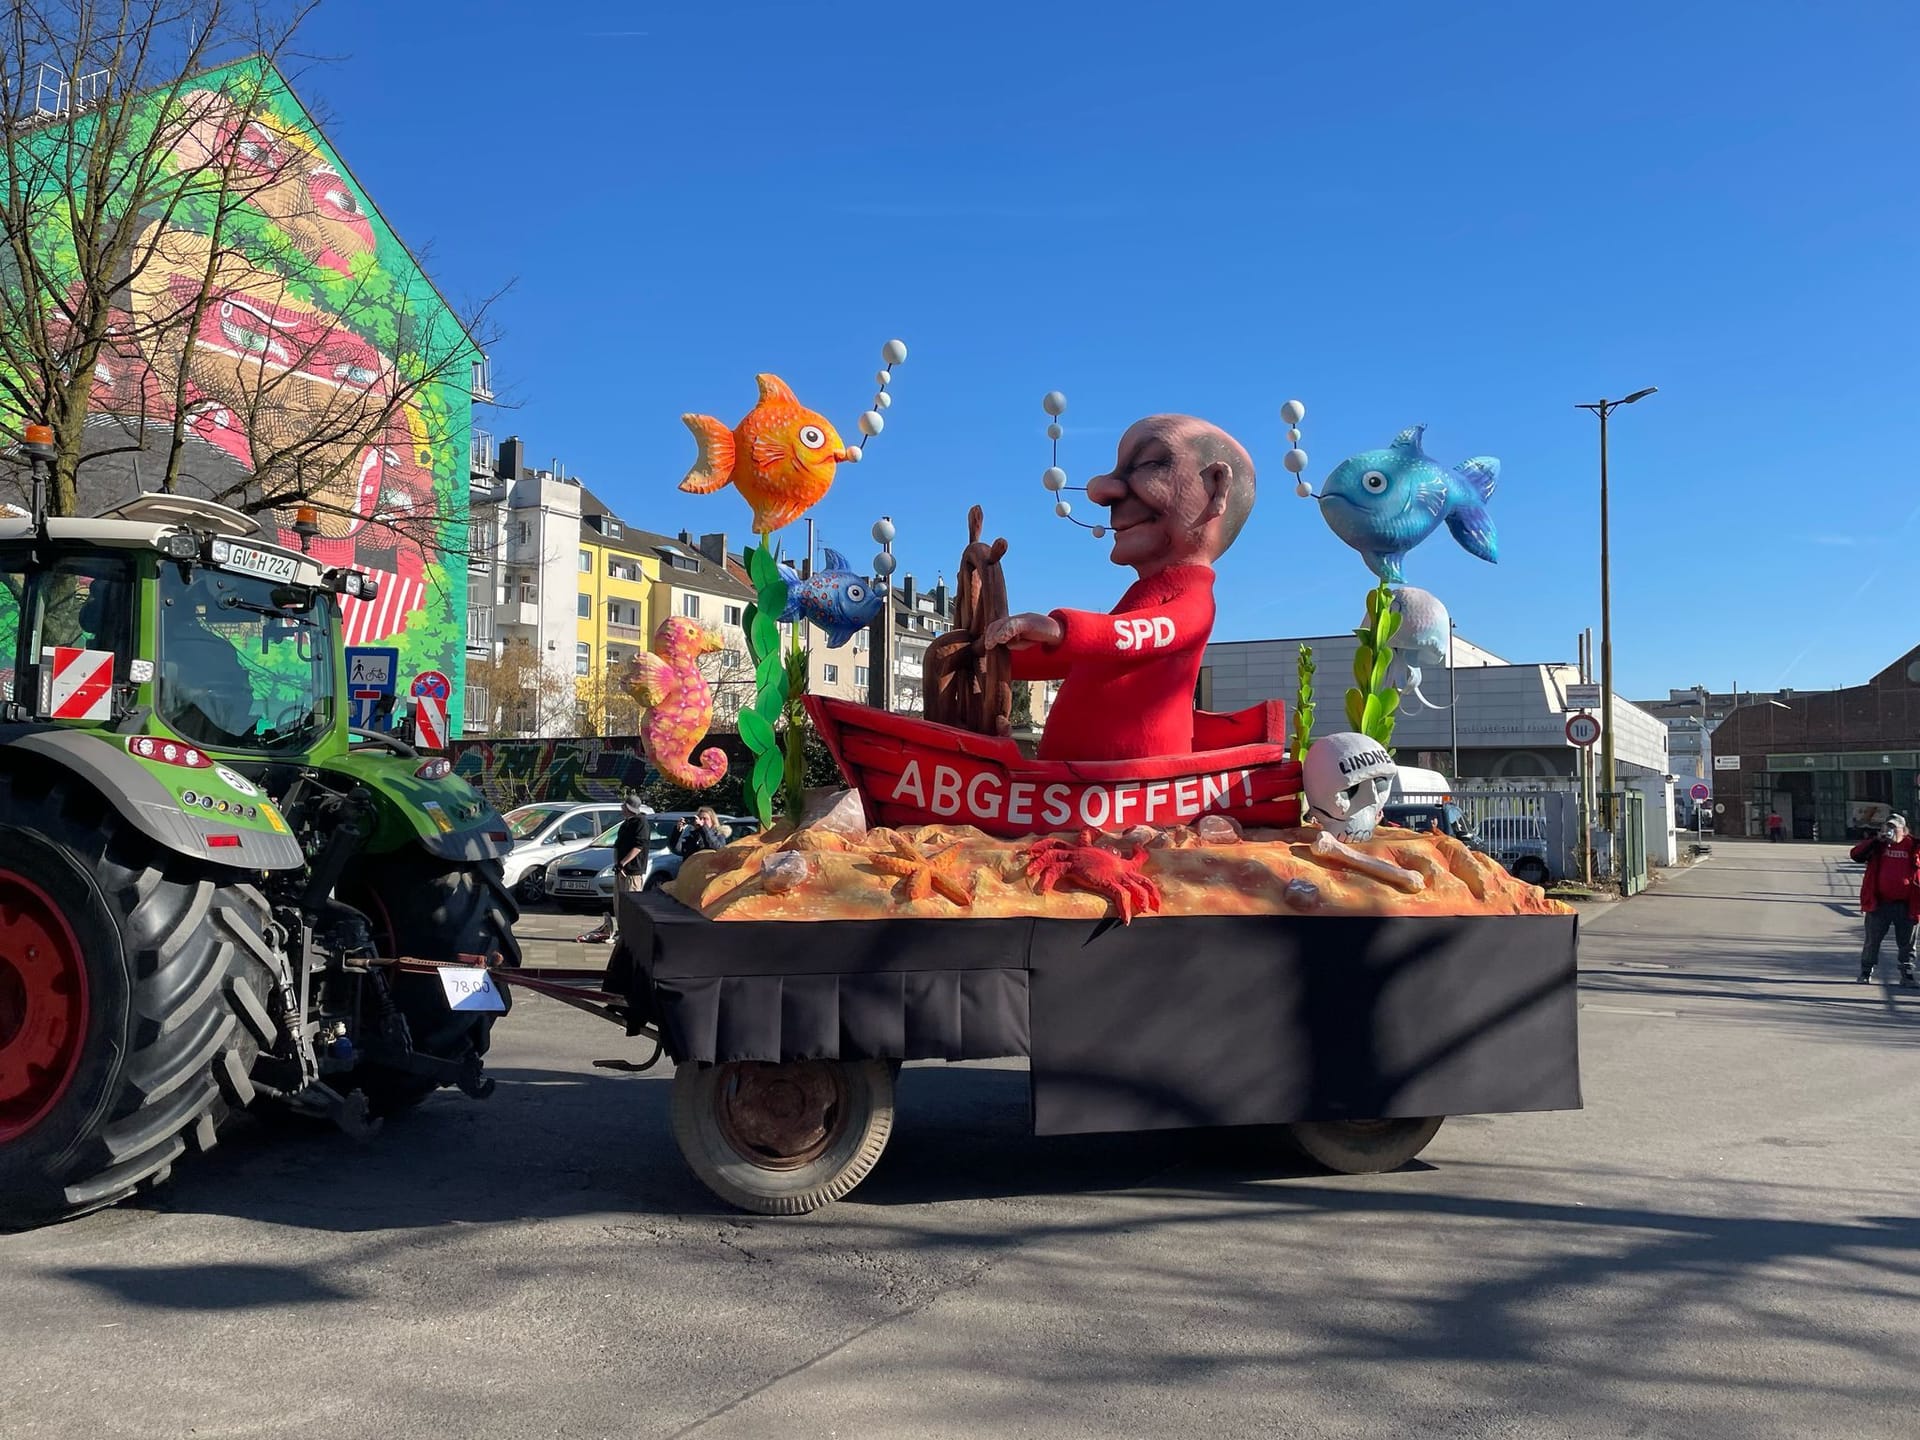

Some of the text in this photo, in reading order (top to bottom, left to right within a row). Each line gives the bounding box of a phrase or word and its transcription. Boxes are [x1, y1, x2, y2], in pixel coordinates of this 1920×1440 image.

[233, 548, 252, 566] GV
[268, 557, 292, 577] 724
[1114, 616, 1176, 650] SPD
[1575, 724, 1588, 738] 10
[219, 770, 253, 792] 50
